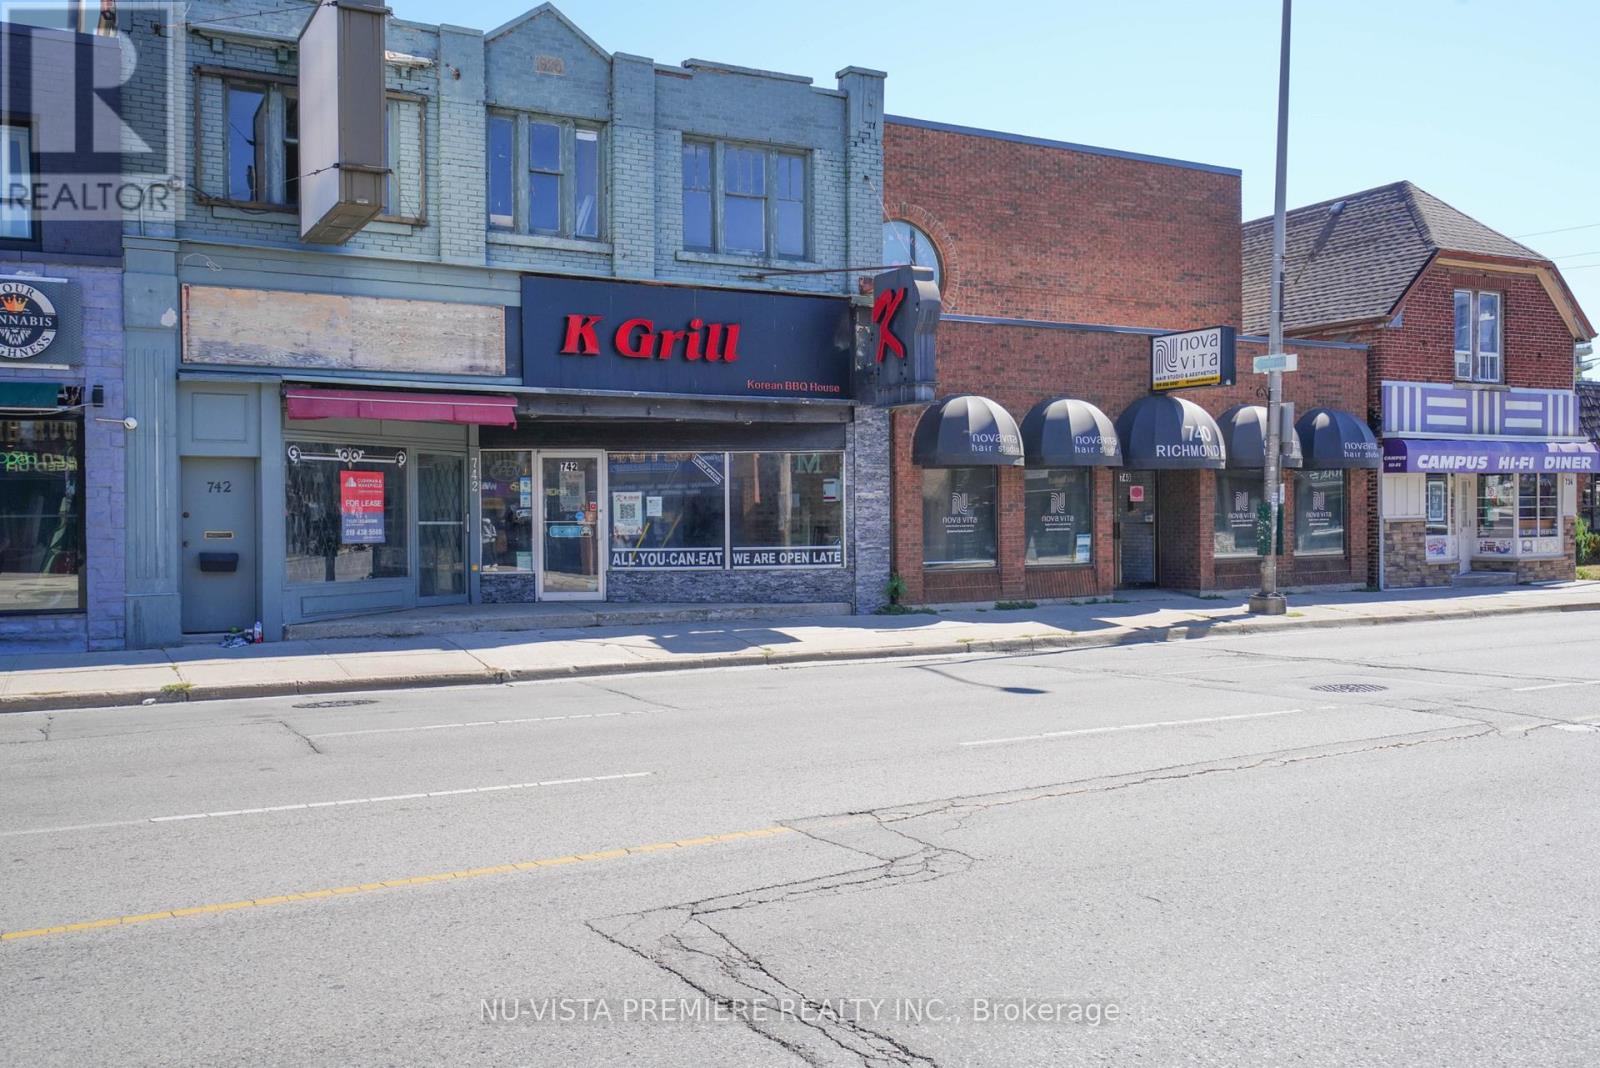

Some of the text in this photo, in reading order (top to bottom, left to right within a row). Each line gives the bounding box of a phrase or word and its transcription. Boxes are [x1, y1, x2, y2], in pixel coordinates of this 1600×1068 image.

[872, 287, 905, 363] K
[560, 313, 740, 363] K Grill
[1180, 332, 1218, 351] nova
[747, 379, 840, 393] Korean BBQ House
[1184, 425, 1212, 442] 740
[971, 443, 993, 452] hair
[1074, 445, 1095, 454] hair
[1155, 444, 1220, 457] RICHMOND
[1344, 450, 1361, 458] hair
[560, 461, 578, 472] 742
[1417, 454, 1488, 470] CAMPUS
[1544, 456, 1592, 470] DINER
[470, 457, 478, 492] 742
[206, 480, 232, 493] 742
[345, 499, 383, 508] FOR LEASE
[732, 551, 841, 565] WE ARE OPEN LATE
